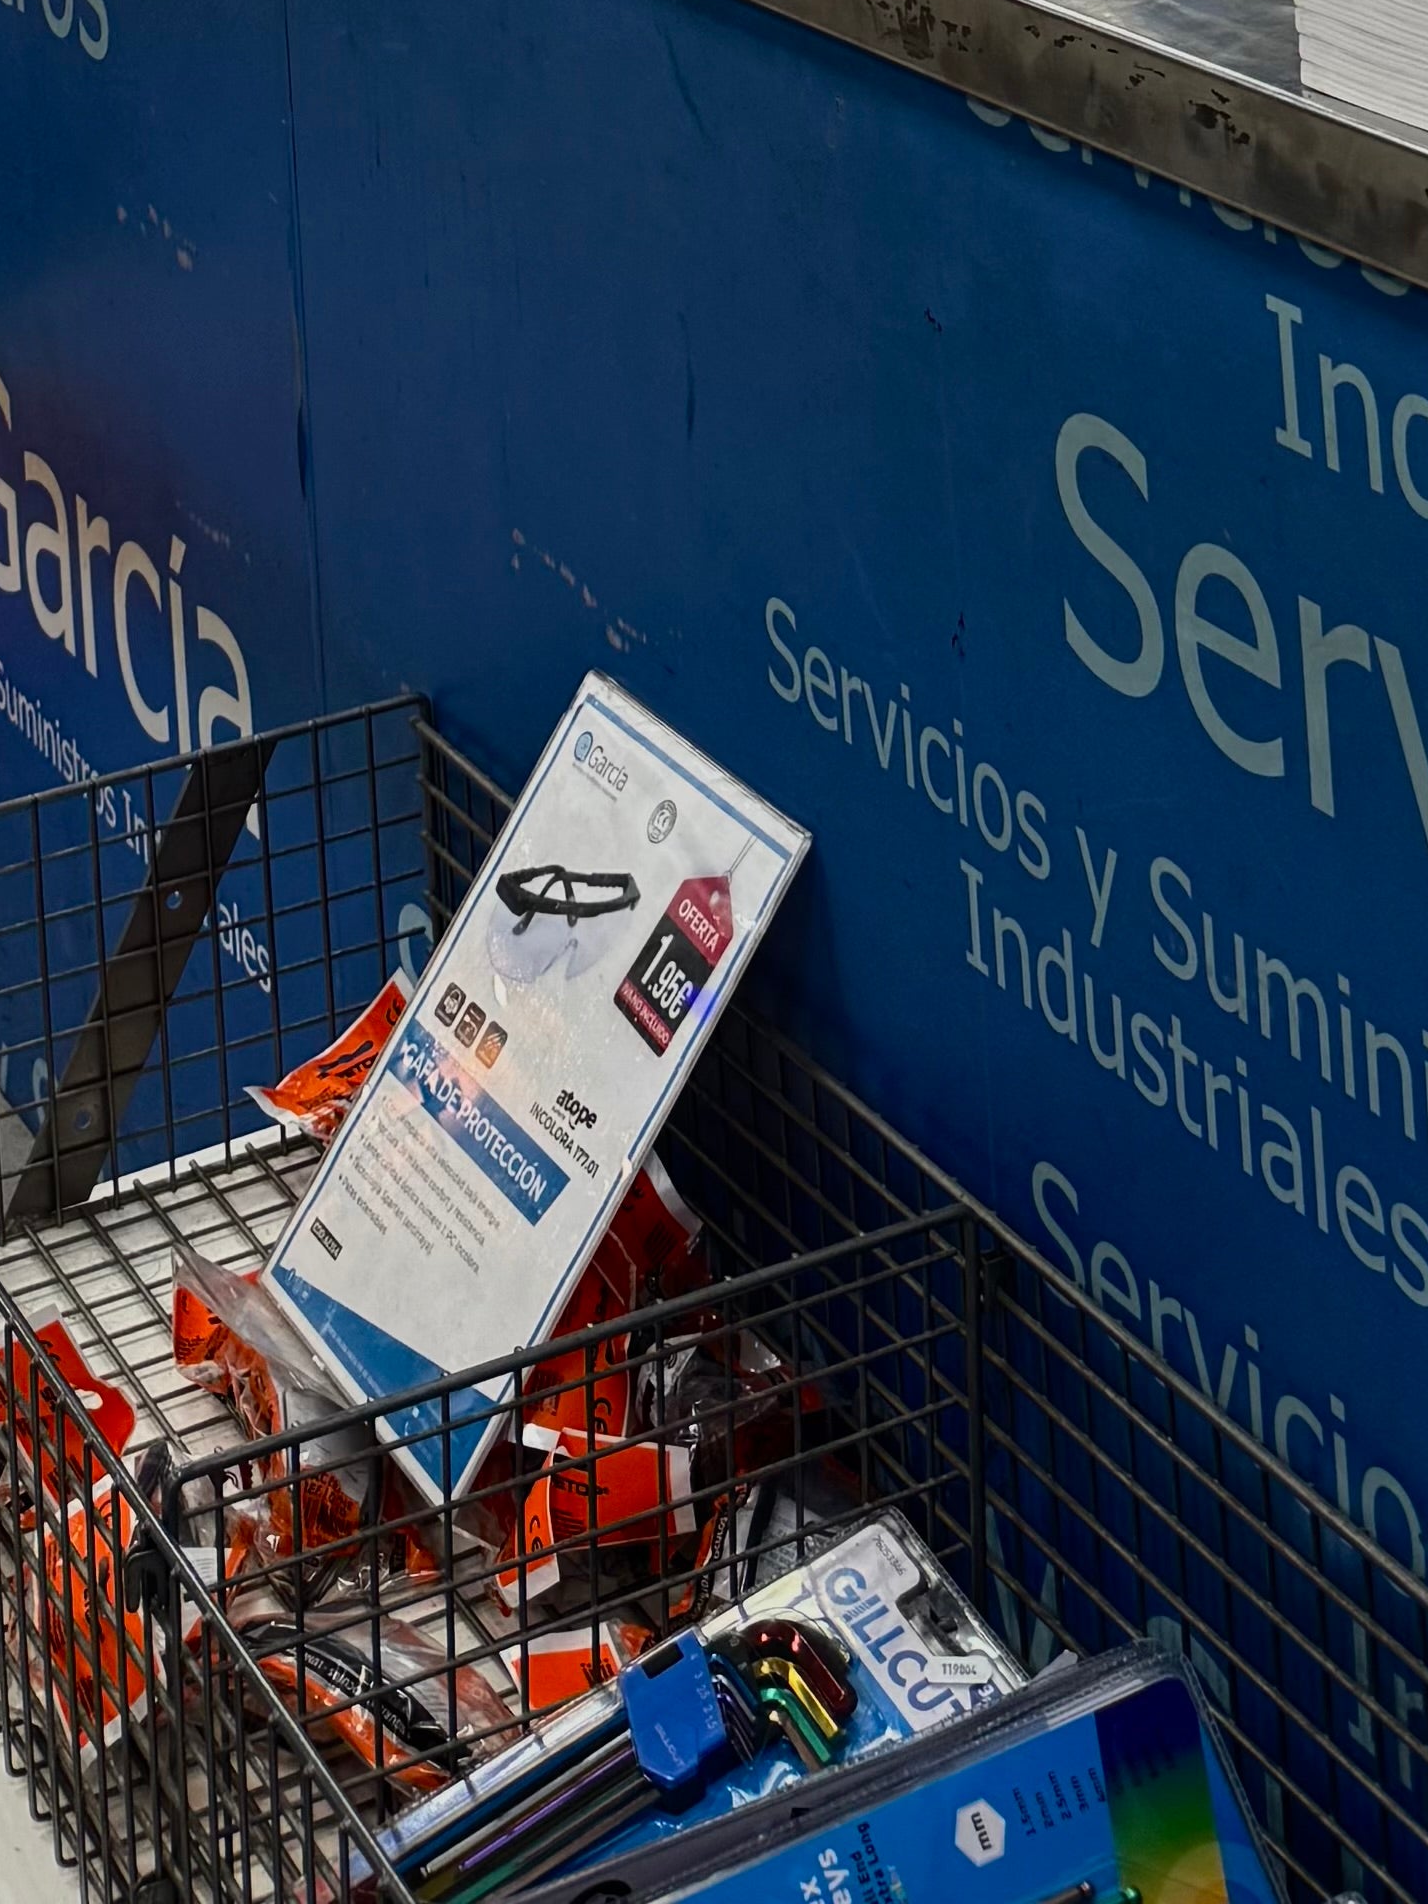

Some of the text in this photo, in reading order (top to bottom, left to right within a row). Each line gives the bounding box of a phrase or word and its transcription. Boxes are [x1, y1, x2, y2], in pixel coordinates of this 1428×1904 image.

[587, 744, 630, 793] García
[765, 595, 1051, 881] Servicios
[1075, 826, 1118, 949] y
[678, 898, 721, 954] OFERTA
[529, 1101, 574, 1156] INCOLORA
[555, 1088, 598, 1130] atope
[436, 1078, 548, 1203] DE PROTECCIÓN
[823, 1566, 967, 1722] GILLCUT
[970, 1809, 993, 1852] mm
[818, 1847, 854, 1904] eys
